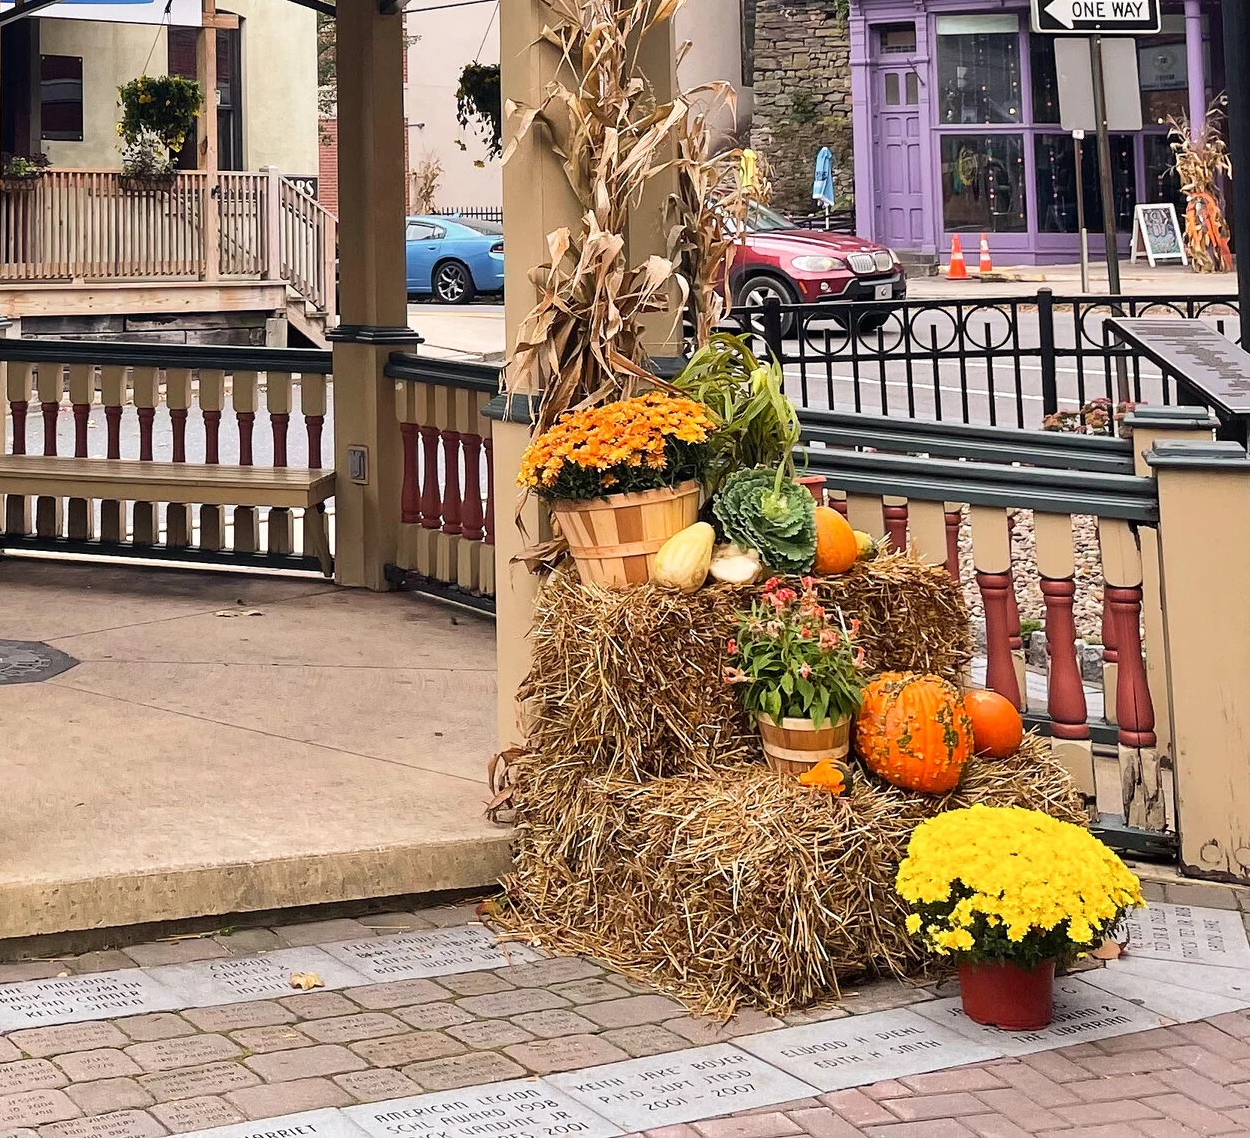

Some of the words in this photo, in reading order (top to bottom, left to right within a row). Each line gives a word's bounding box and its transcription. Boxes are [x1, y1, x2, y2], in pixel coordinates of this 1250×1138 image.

[1072, 2, 1106, 17] ONE
[1112, 2, 1143, 17] WAY
[25, 1006, 75, 1019] KELLY
[1011, 1032, 1048, 1045] THE
[1049, 1014, 1134, 1037] LIBRARIAN
[780, 1040, 849, 1059] ELWOOD
[813, 1055, 864, 1070] EDITH
[889, 1038, 944, 1056] SMITH
[574, 1077, 626, 1094] KEITH
[690, 1055, 749, 1072] BOYER
[651, 1079, 696, 1095] SUPT
[373, 1100, 469, 1124] AMERICAN
[476, 1088, 542, 1106] LEGION
[642, 1096, 689, 1111] 2001
[710, 1082, 758, 1098] 2007
[386, 1121, 435, 1135] SCHL
[440, 1107, 507, 1126] AWARD
[514, 1100, 559, 1113] 1998
[458, 1116, 542, 1136] VANDINE
[549, 1110, 573, 1122] JR
[542, 1121, 590, 1136] 2001
